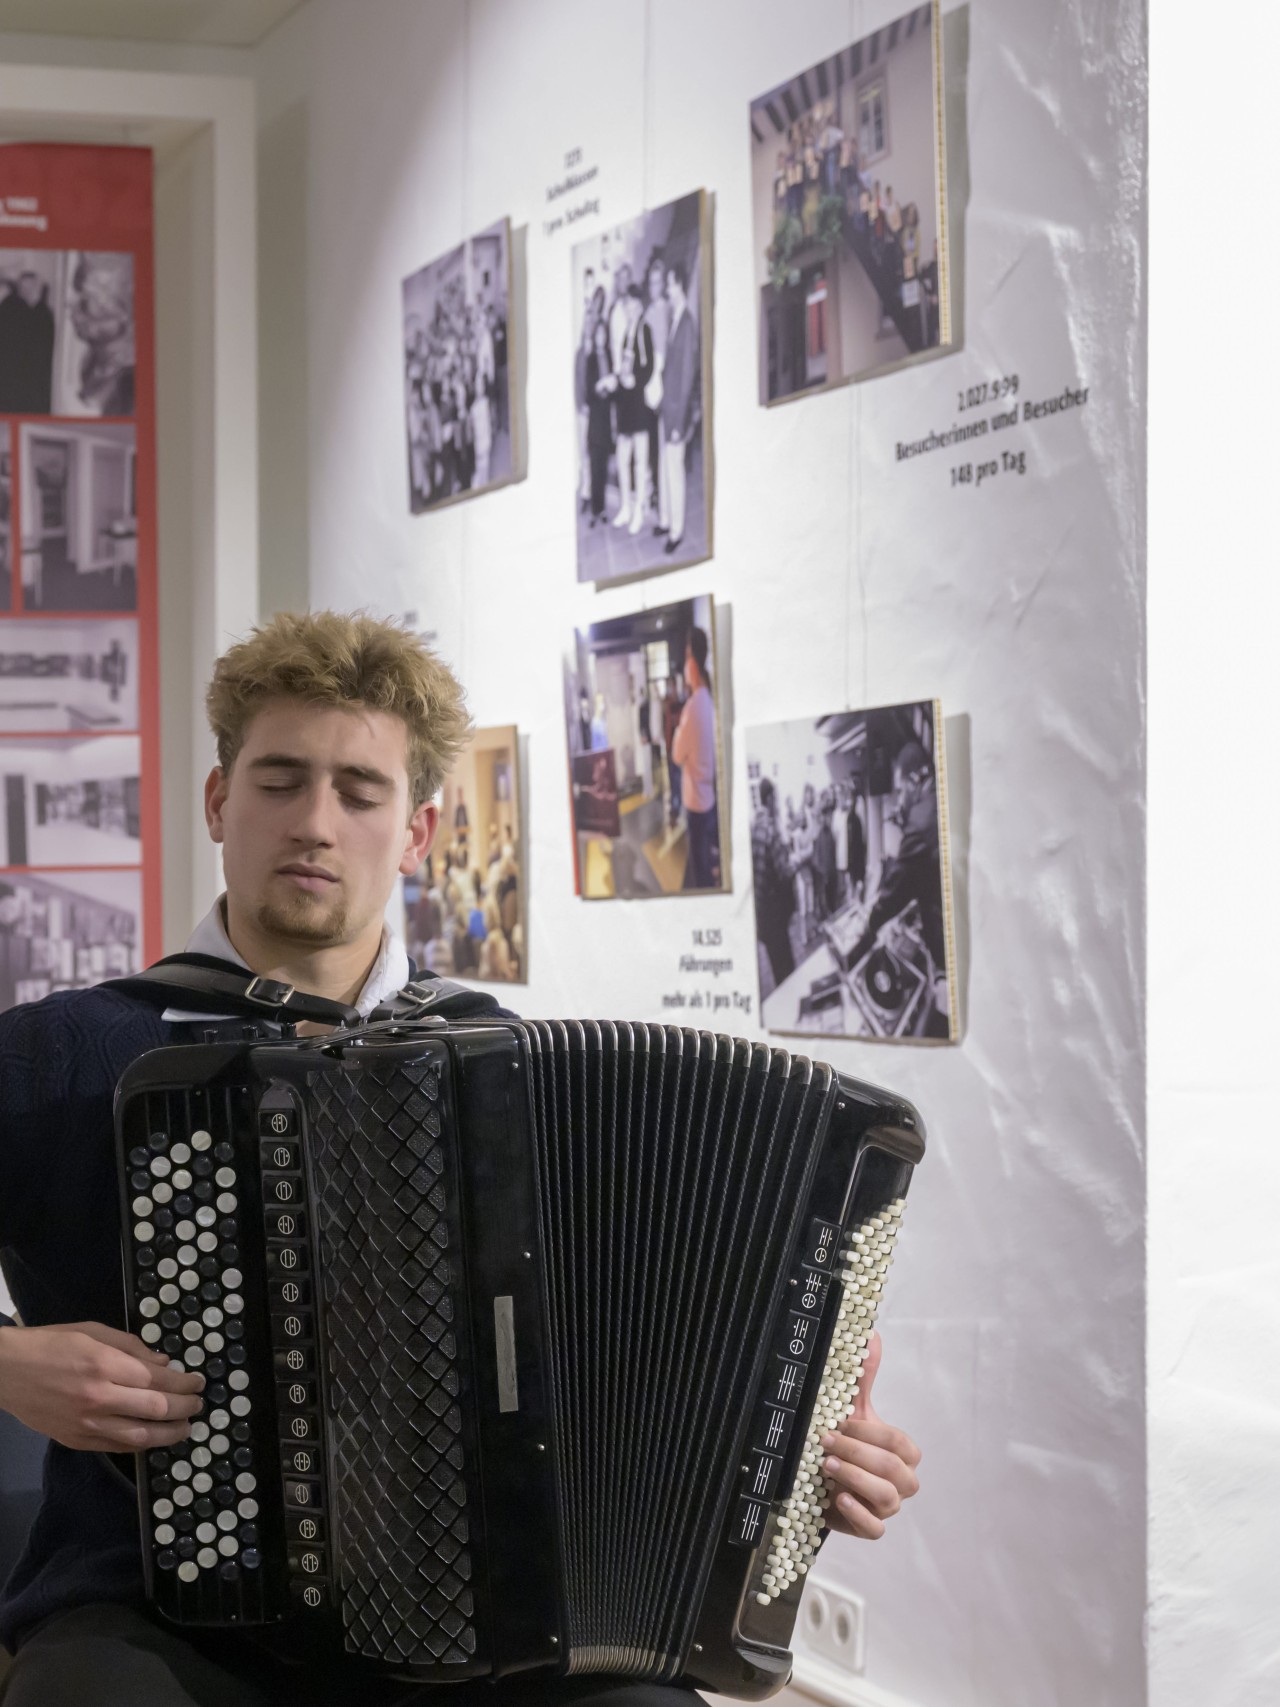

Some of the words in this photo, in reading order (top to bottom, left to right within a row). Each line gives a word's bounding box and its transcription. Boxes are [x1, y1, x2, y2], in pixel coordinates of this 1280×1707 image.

[895, 422, 990, 462] Besucherinnen
[991, 404, 1019, 432] und
[1023, 385, 1090, 422] Besucher
[950, 463, 974, 488] 148
[975, 461, 998, 487] pro
[1001, 450, 1027, 475] Tag
